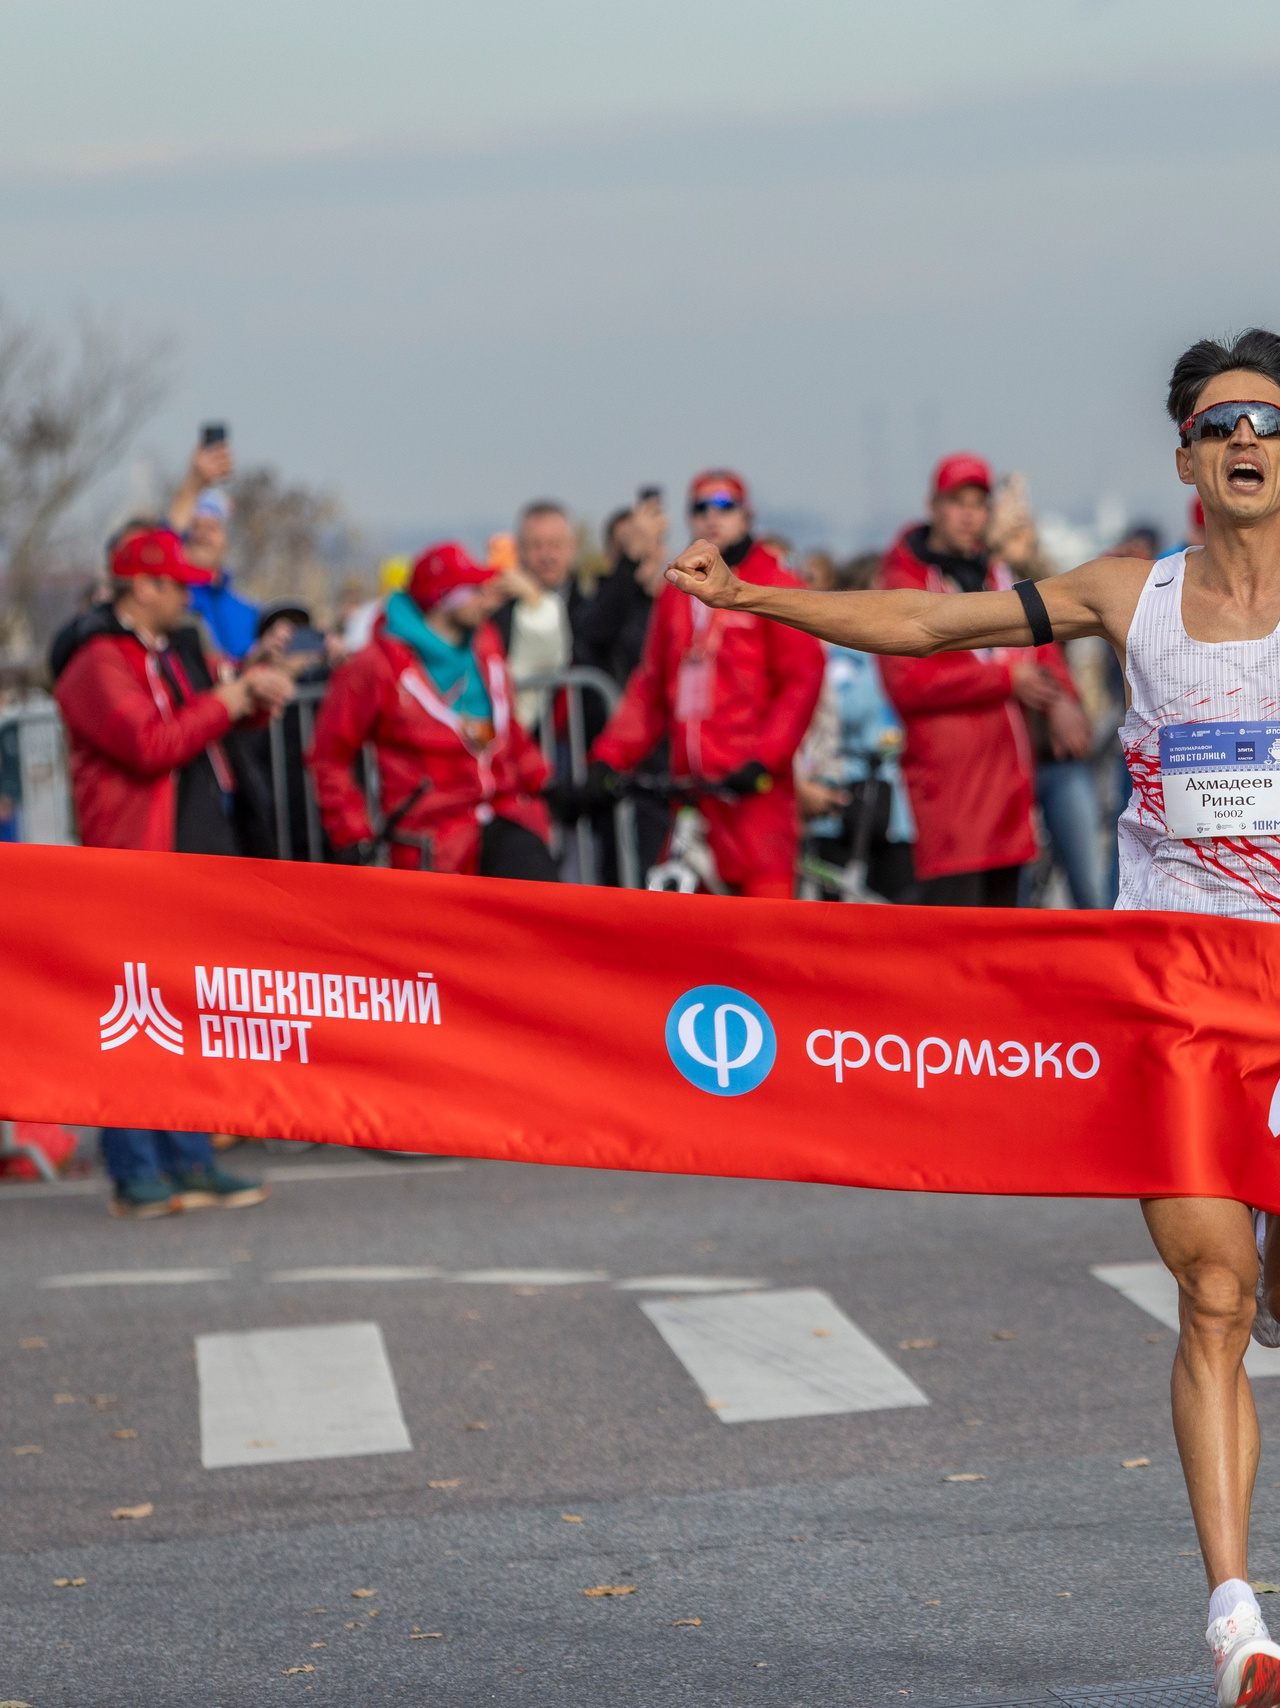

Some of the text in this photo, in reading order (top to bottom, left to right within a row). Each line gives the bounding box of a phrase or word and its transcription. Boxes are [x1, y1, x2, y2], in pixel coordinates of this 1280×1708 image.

[1170, 752, 1226, 763] МОЯ СТОЛИЦА
[1185, 777, 1273, 791] Ахмадеев
[1202, 793, 1256, 807] Ринас
[1214, 809, 1244, 818] 16002
[194, 965, 441, 1025] МОСКОВСКИЙ
[199, 1014, 312, 1064] СПОРТ
[805, 1028, 1101, 1089] фармэко
